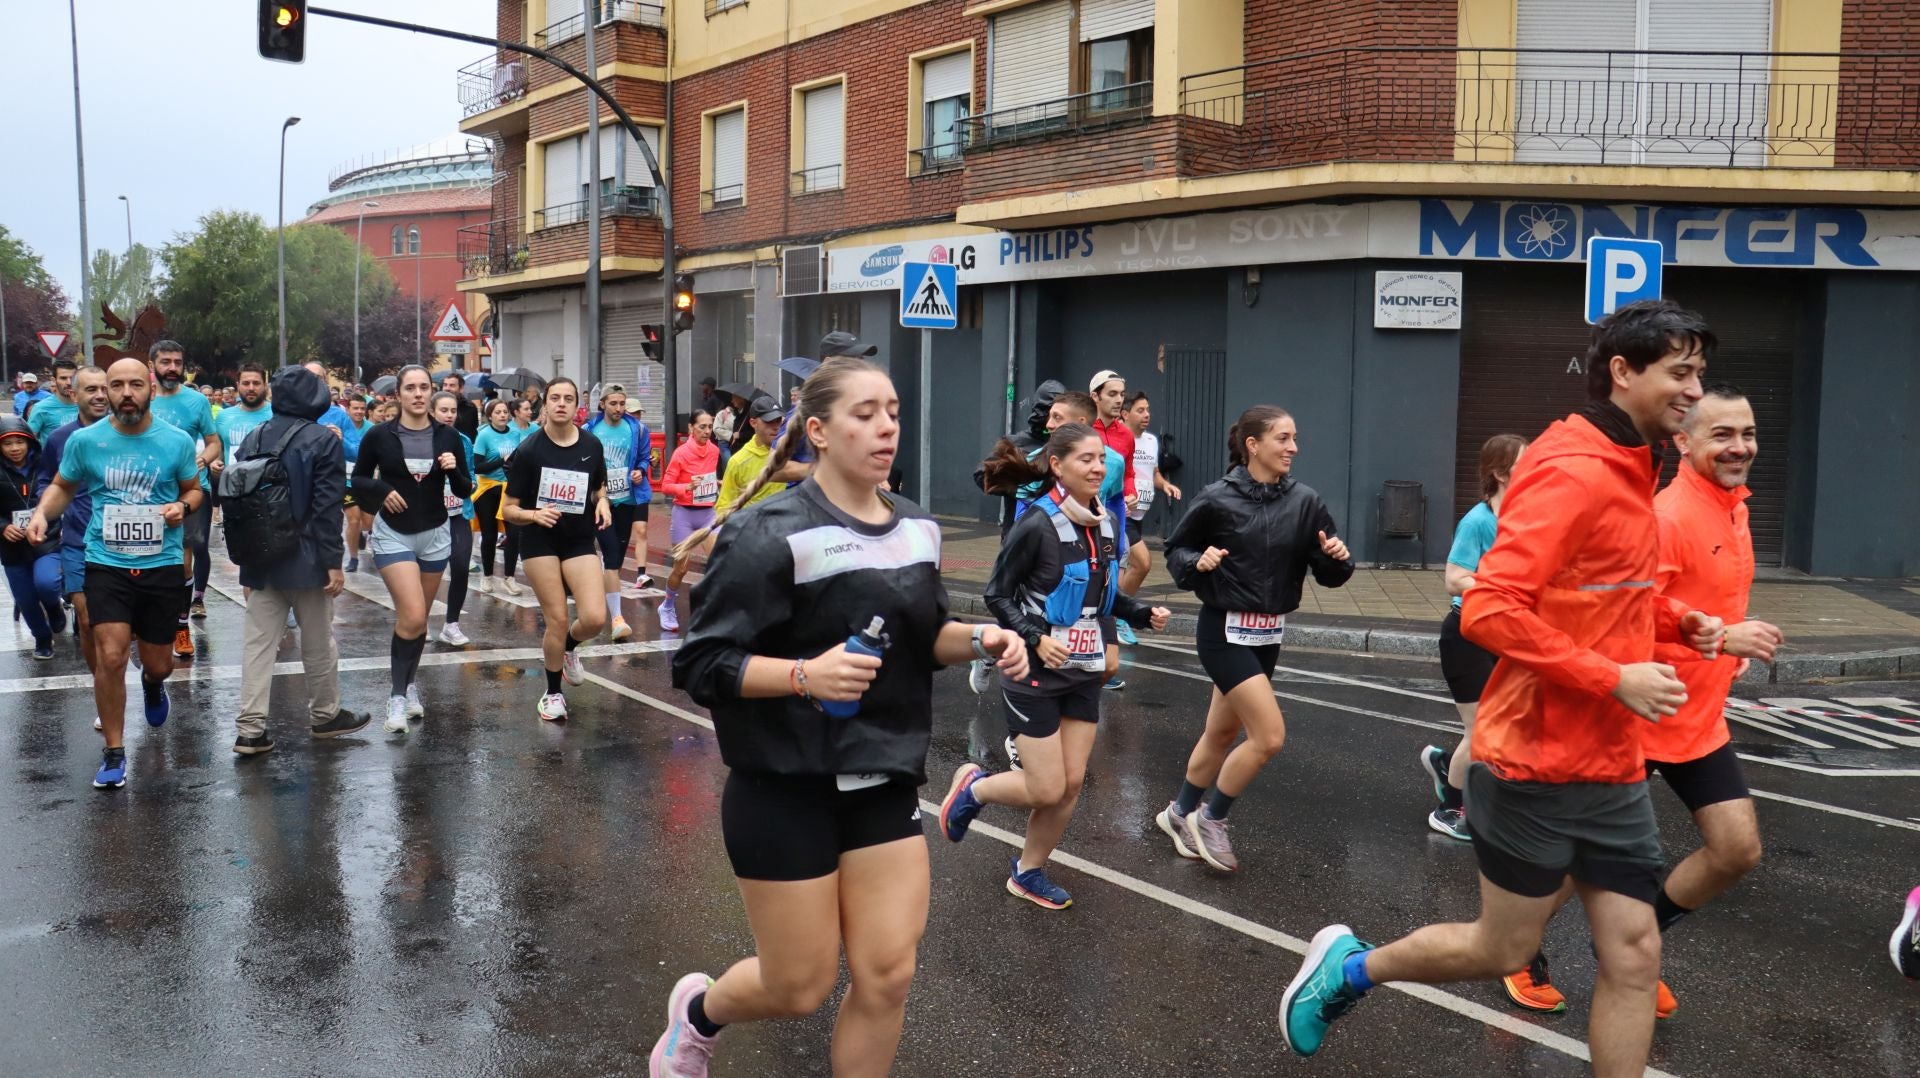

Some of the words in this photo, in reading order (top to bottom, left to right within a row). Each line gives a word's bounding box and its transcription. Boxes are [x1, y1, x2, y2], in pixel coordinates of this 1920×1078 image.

[1229, 210, 1349, 244] SONY
[1419, 199, 1881, 267] MONFER
[1000, 226, 1094, 265] PHILIPS
[1120, 218, 1198, 256] JVC
[865, 255, 900, 268] SAMSUN
[1113, 254, 1208, 271] TECNICA
[830, 278, 895, 291] SERVICIO
[1603, 249, 1647, 314] P
[1380, 295, 1459, 308] MONFER
[550, 483, 577, 501] 1148
[115, 522, 153, 541] 1050
[824, 541, 865, 557] macrn
